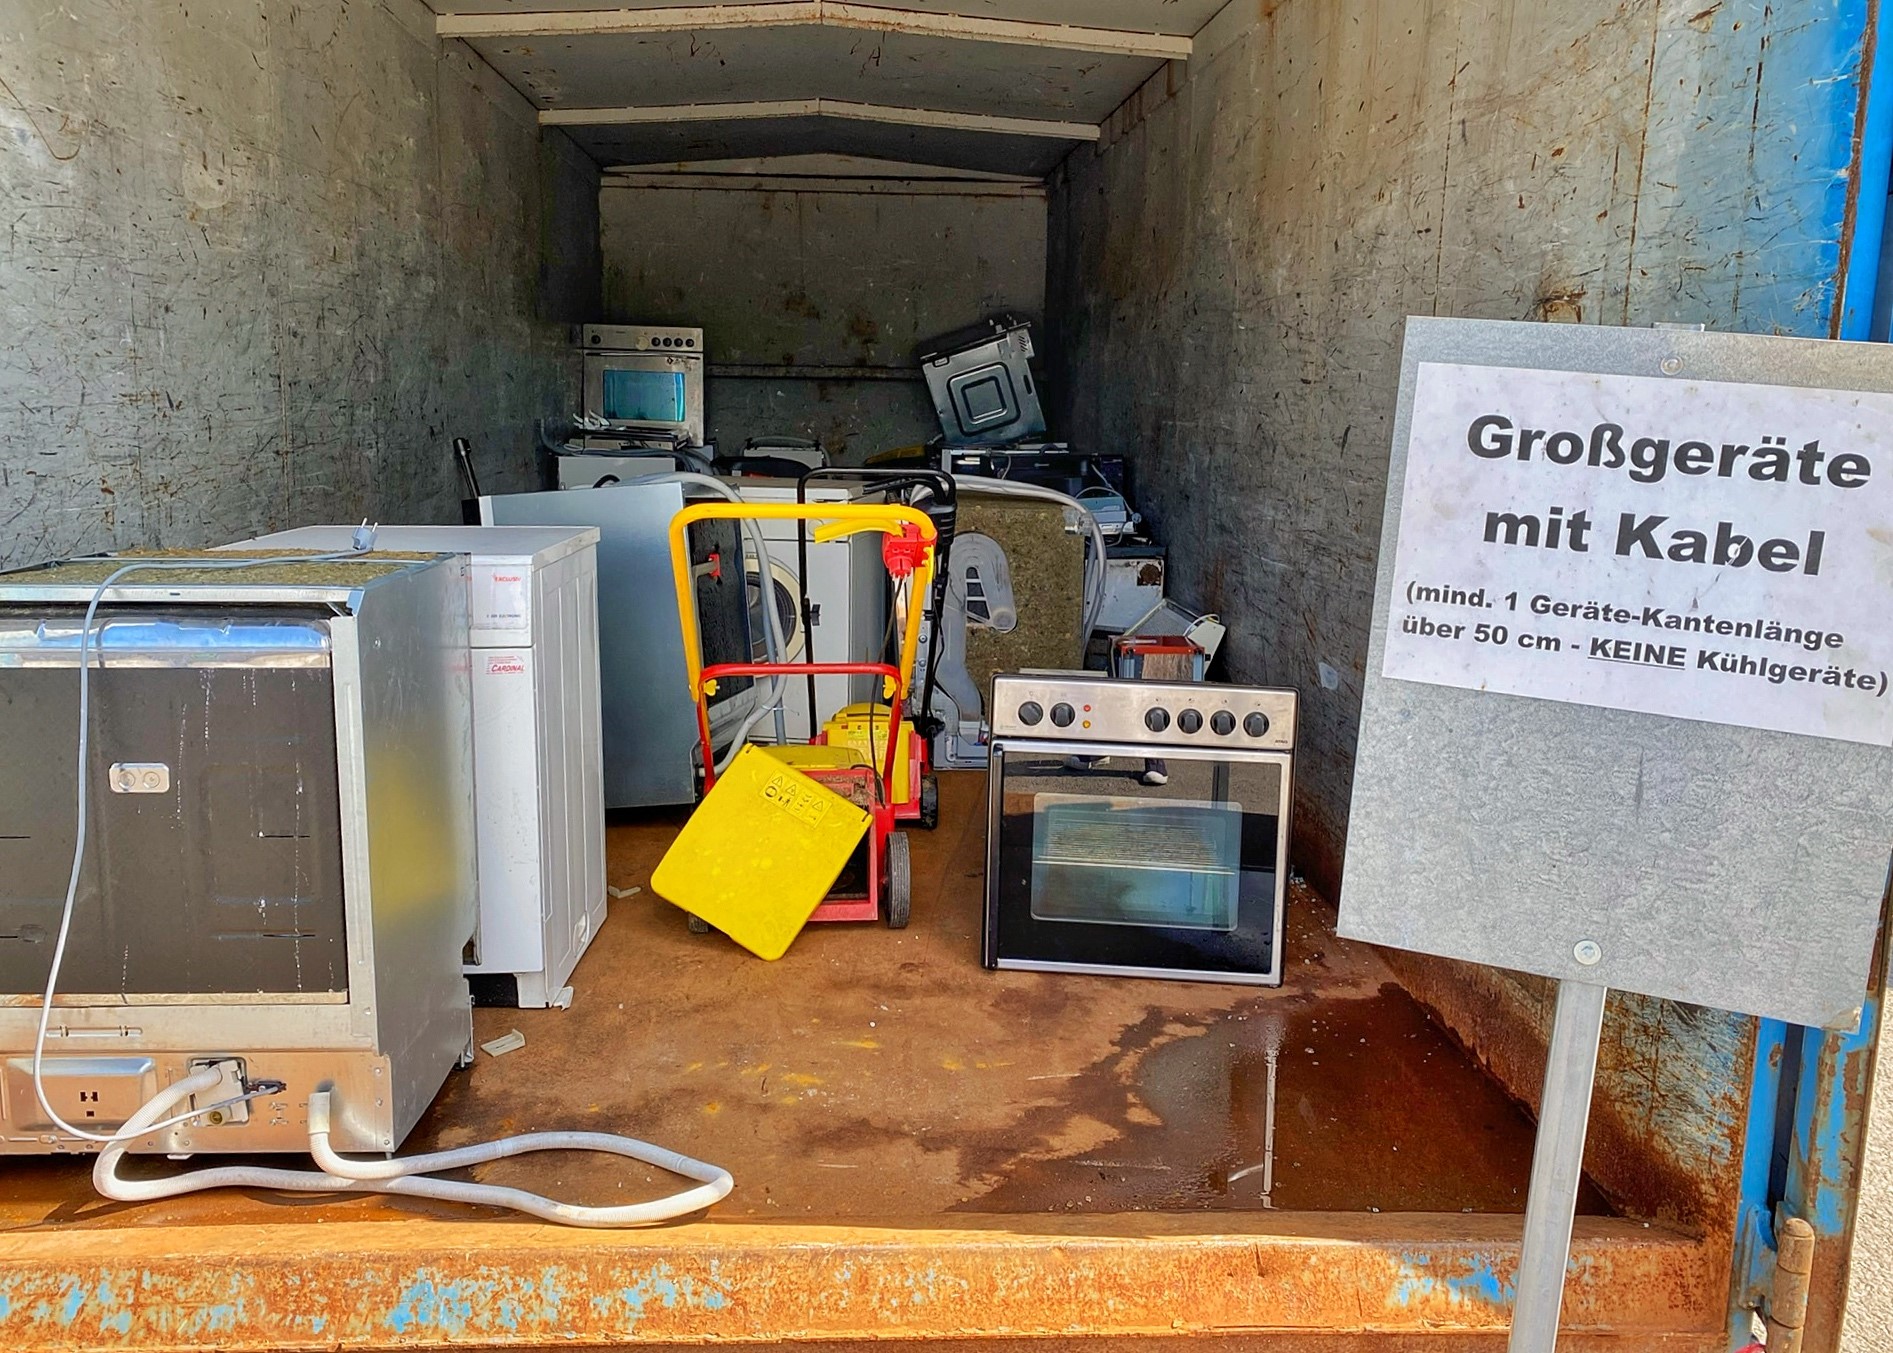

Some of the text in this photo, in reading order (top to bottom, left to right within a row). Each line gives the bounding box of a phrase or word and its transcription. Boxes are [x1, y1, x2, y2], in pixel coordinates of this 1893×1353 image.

[1467, 415, 1871, 489] Großgeräte
[1483, 506, 1825, 576] mit Kabel
[1406, 580, 1844, 650] (mind. 1 Geräte-Kantenlänge
[1402, 615, 1466, 640] über
[1473, 623, 1508, 645] 50
[1517, 634, 1561, 652] cm
[1588, 637, 1687, 668] KEINE
[1697, 650, 1888, 698] Kühlgeräte)
